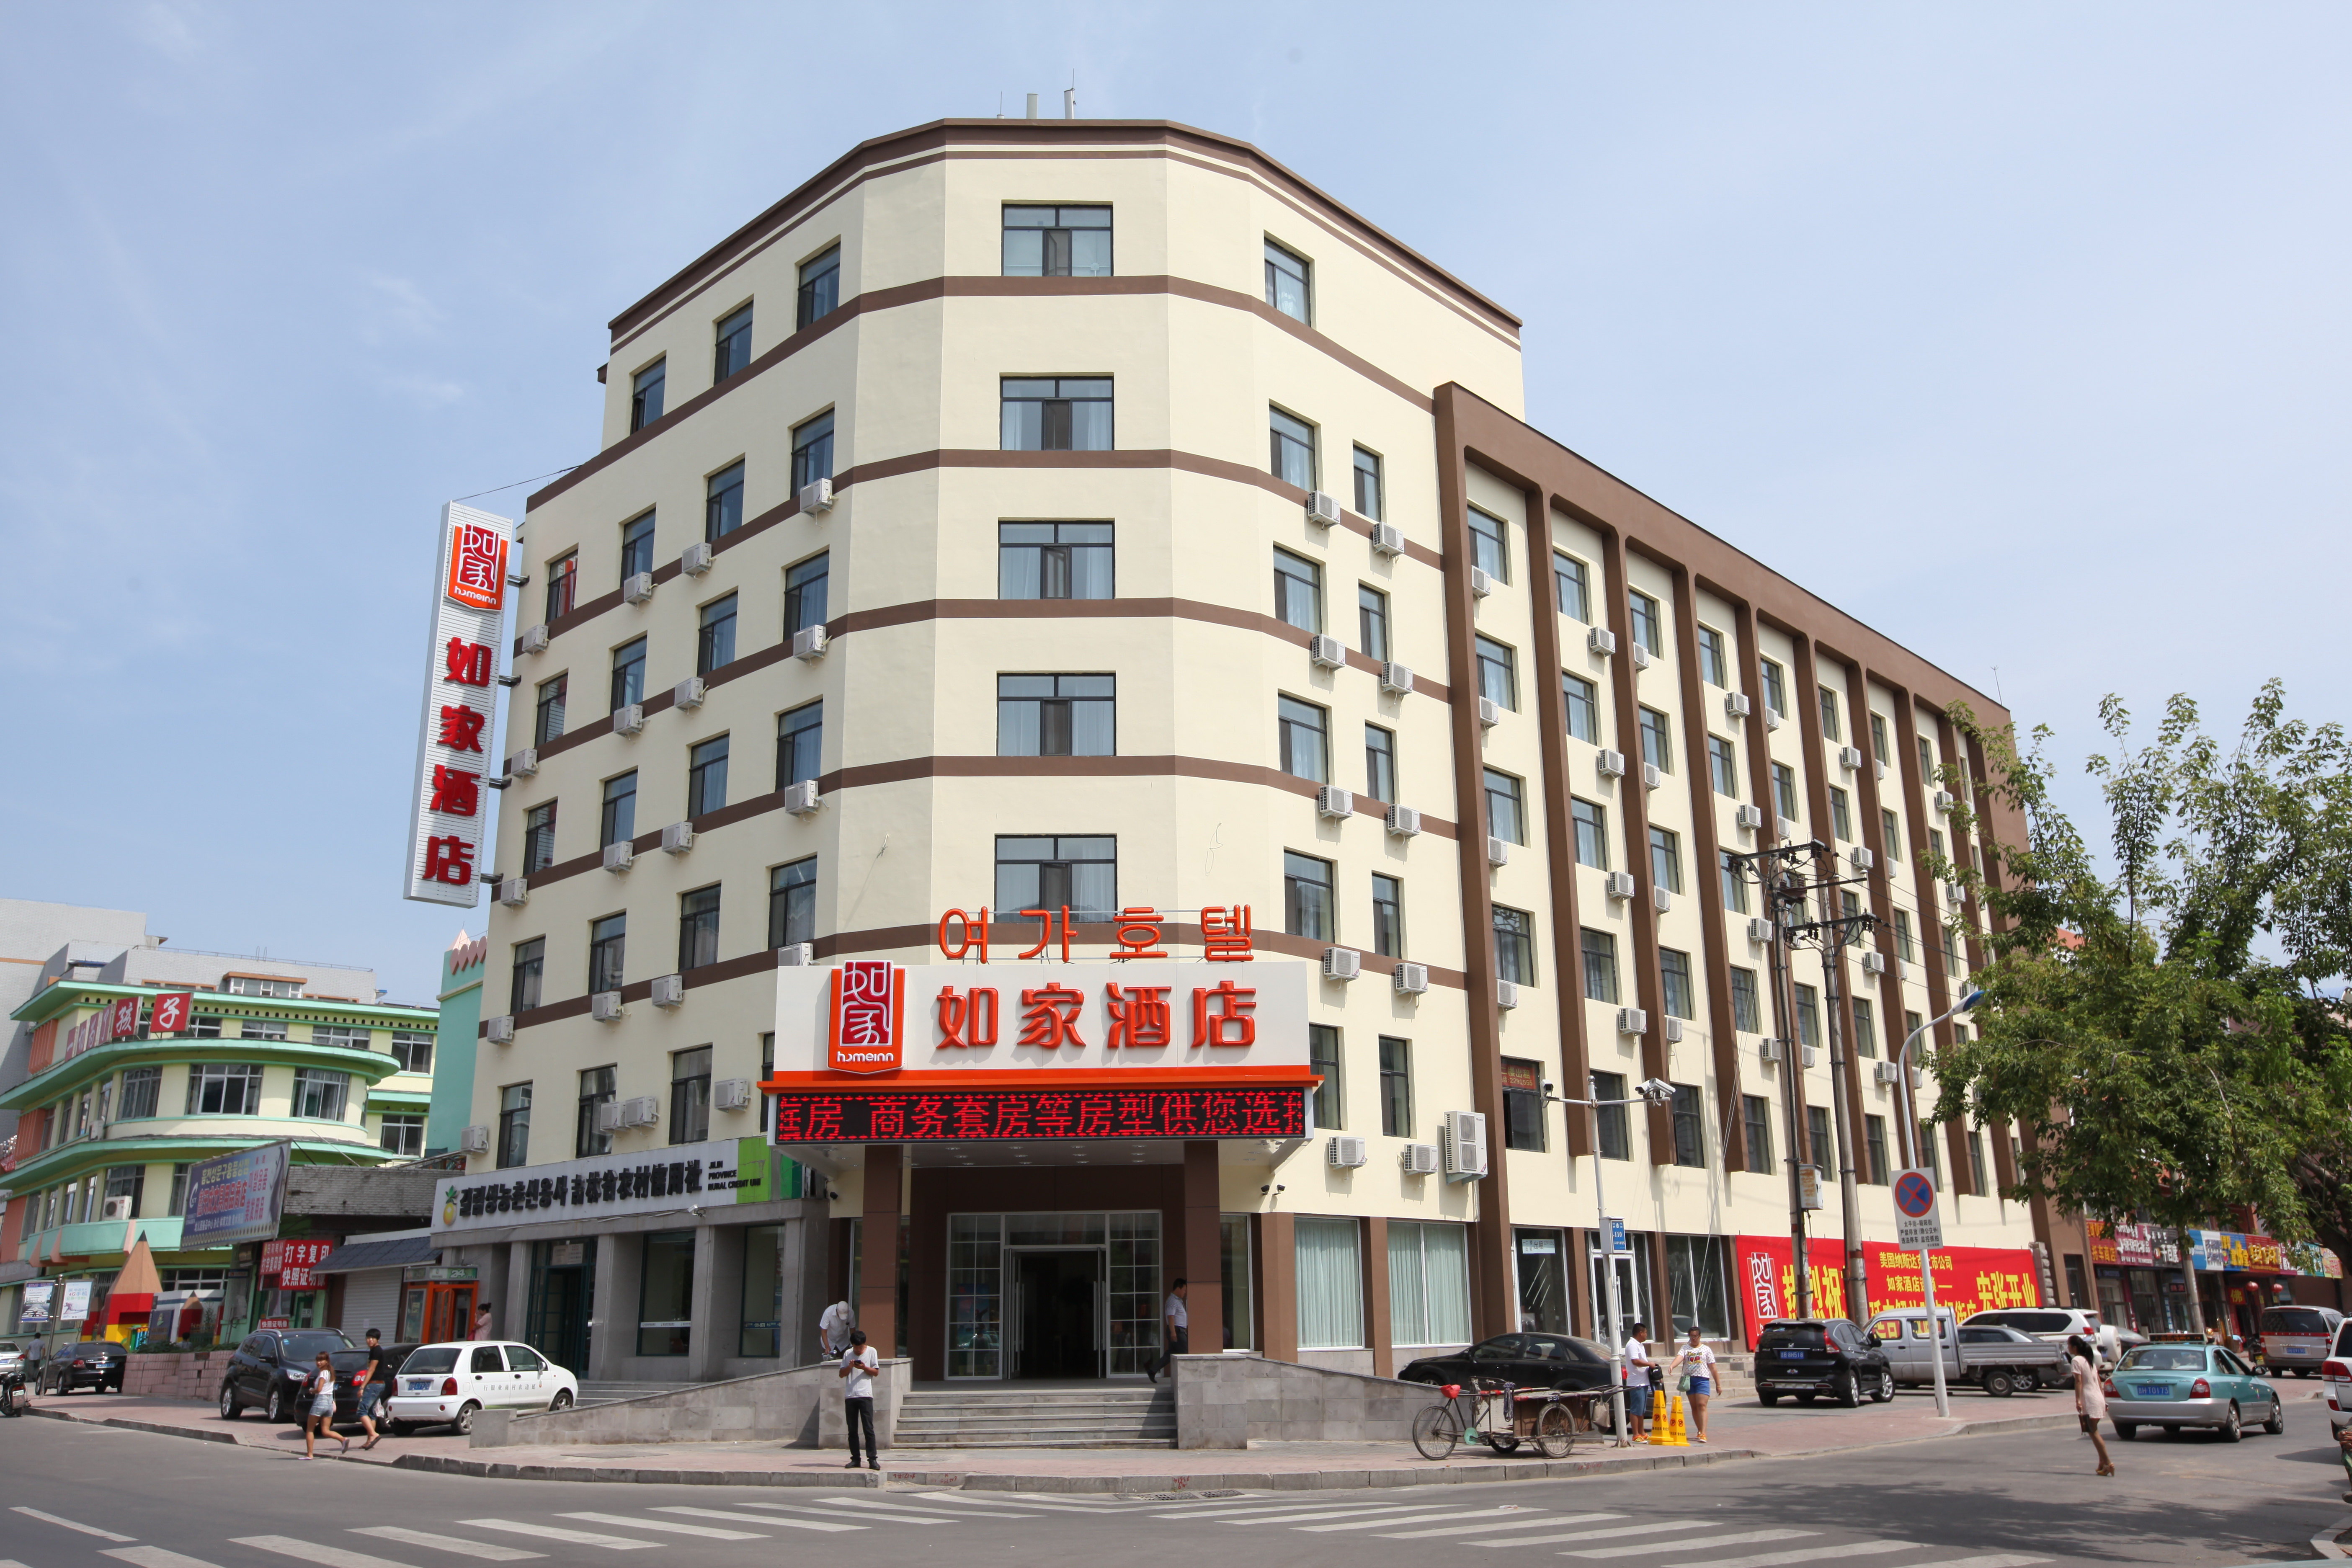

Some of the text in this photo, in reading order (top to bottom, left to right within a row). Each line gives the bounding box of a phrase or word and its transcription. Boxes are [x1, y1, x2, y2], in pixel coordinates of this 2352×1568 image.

[422, 636, 492, 885] 如家酒店
[939, 905, 1255, 963] 여가호텔
[936, 980, 1257, 1050] 如家酒店
[571, 1159, 703, 1205] 吉林省农村信用社
[708, 1169, 737, 1180] PROVINCE
[708, 1183, 727, 1191] RURAL
[728, 1179, 748, 1189] CREDIT
[459, 1175, 568, 1217] 길림성농촌신용사
[285, 1244, 330, 1263] 打字复印
[1534, 1240, 1543, 1249] 出租
